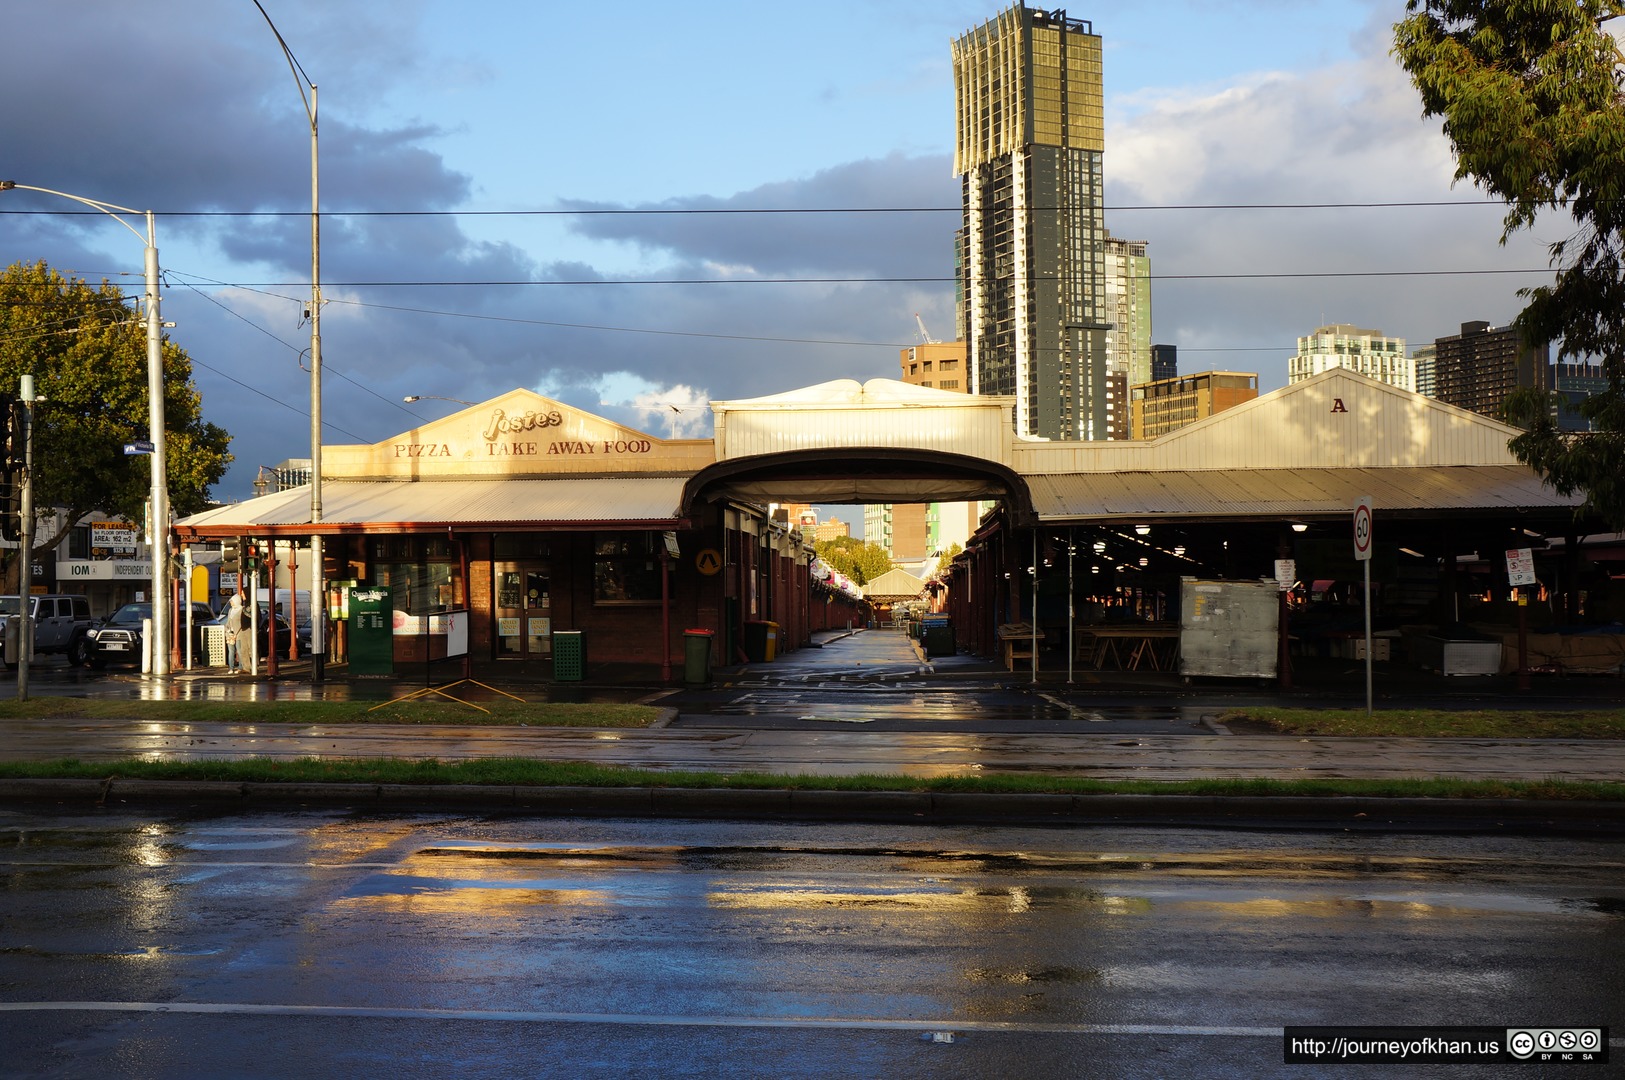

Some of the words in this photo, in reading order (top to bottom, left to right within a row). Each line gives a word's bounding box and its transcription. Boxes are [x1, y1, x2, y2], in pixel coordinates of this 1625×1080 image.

[1330, 398, 1348, 413] A
[394, 444, 452, 458] PIZZA
[486, 442, 537, 456] TAKE
[546, 441, 595, 455] AWAY
[603, 440, 651, 454] FOOD
[1357, 517, 1368, 538] 60
[71, 565, 90, 576] IOM
[114, 564, 144, 575] INDEPENDENT
